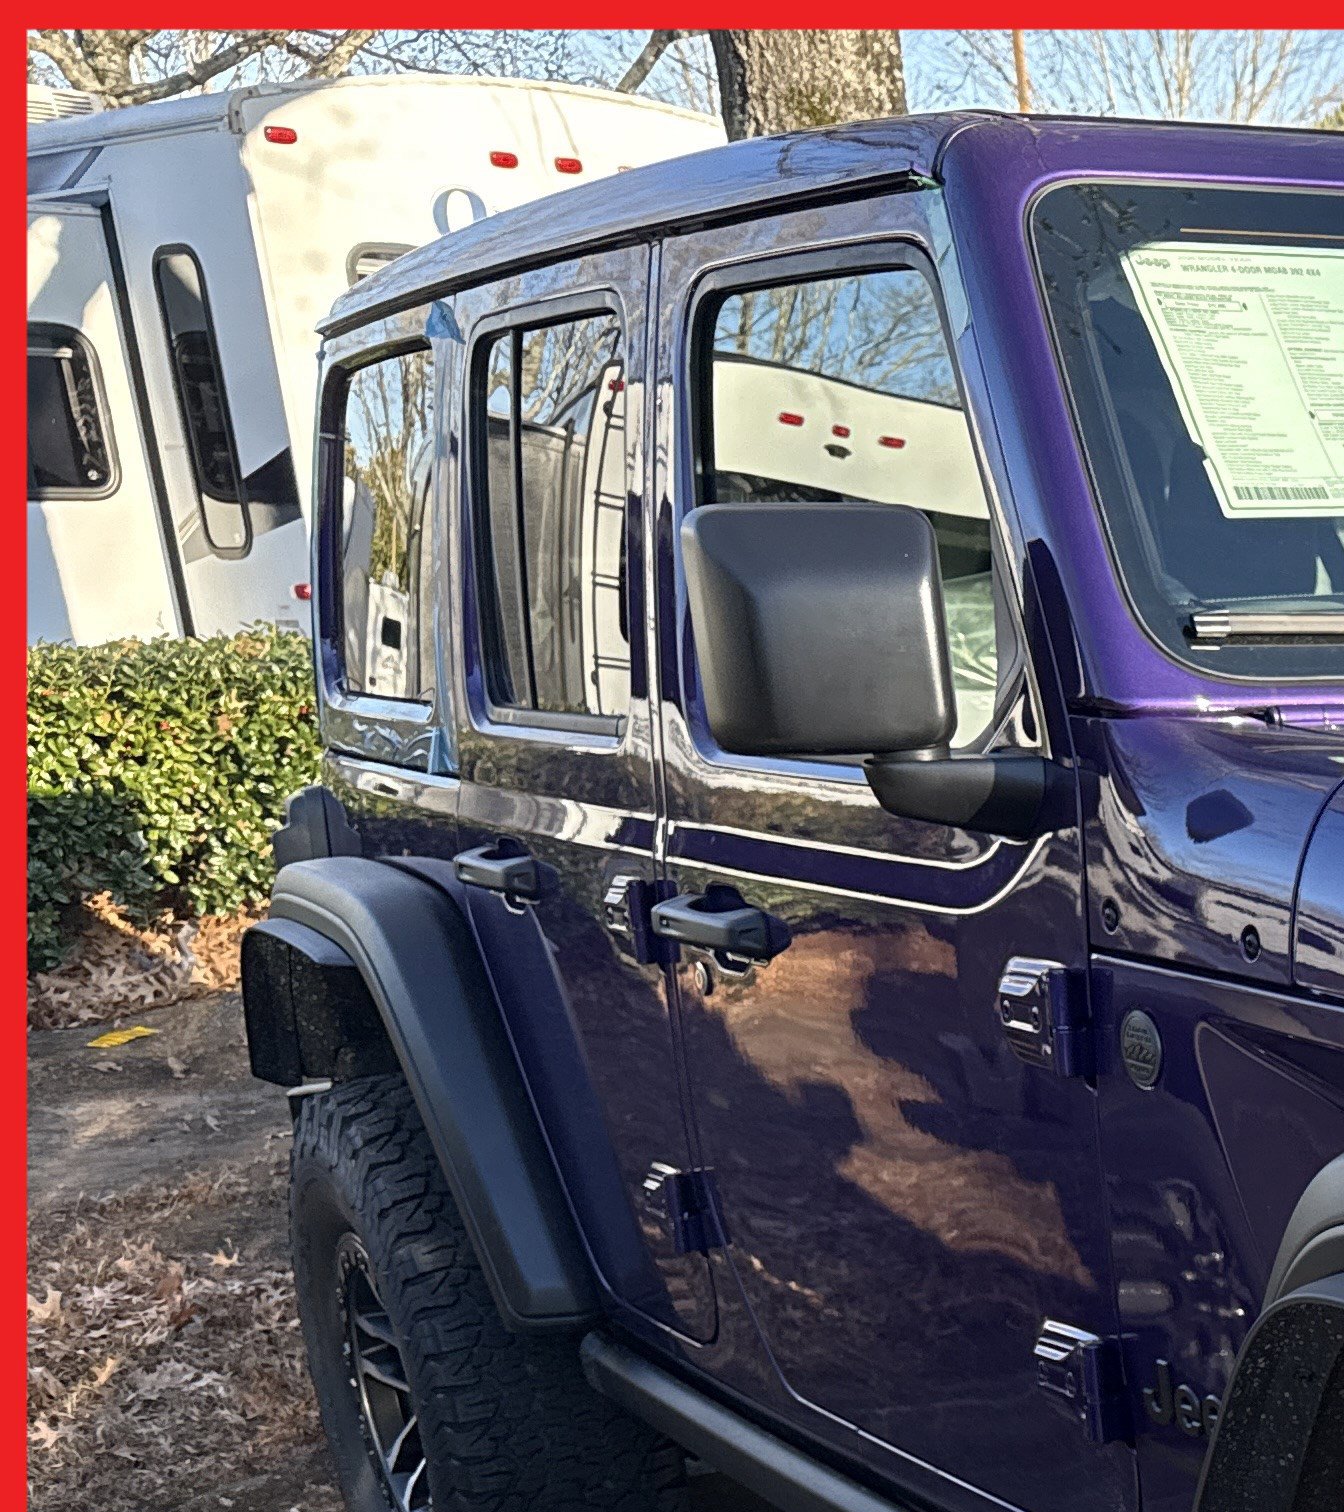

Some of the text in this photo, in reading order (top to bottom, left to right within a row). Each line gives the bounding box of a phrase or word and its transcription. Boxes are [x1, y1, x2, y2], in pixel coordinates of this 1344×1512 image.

[1180, 265, 1229, 273] WRANGLER
[1264, 266, 1288, 275] MOAB
[1142, 1359, 1222, 1437] Jee
